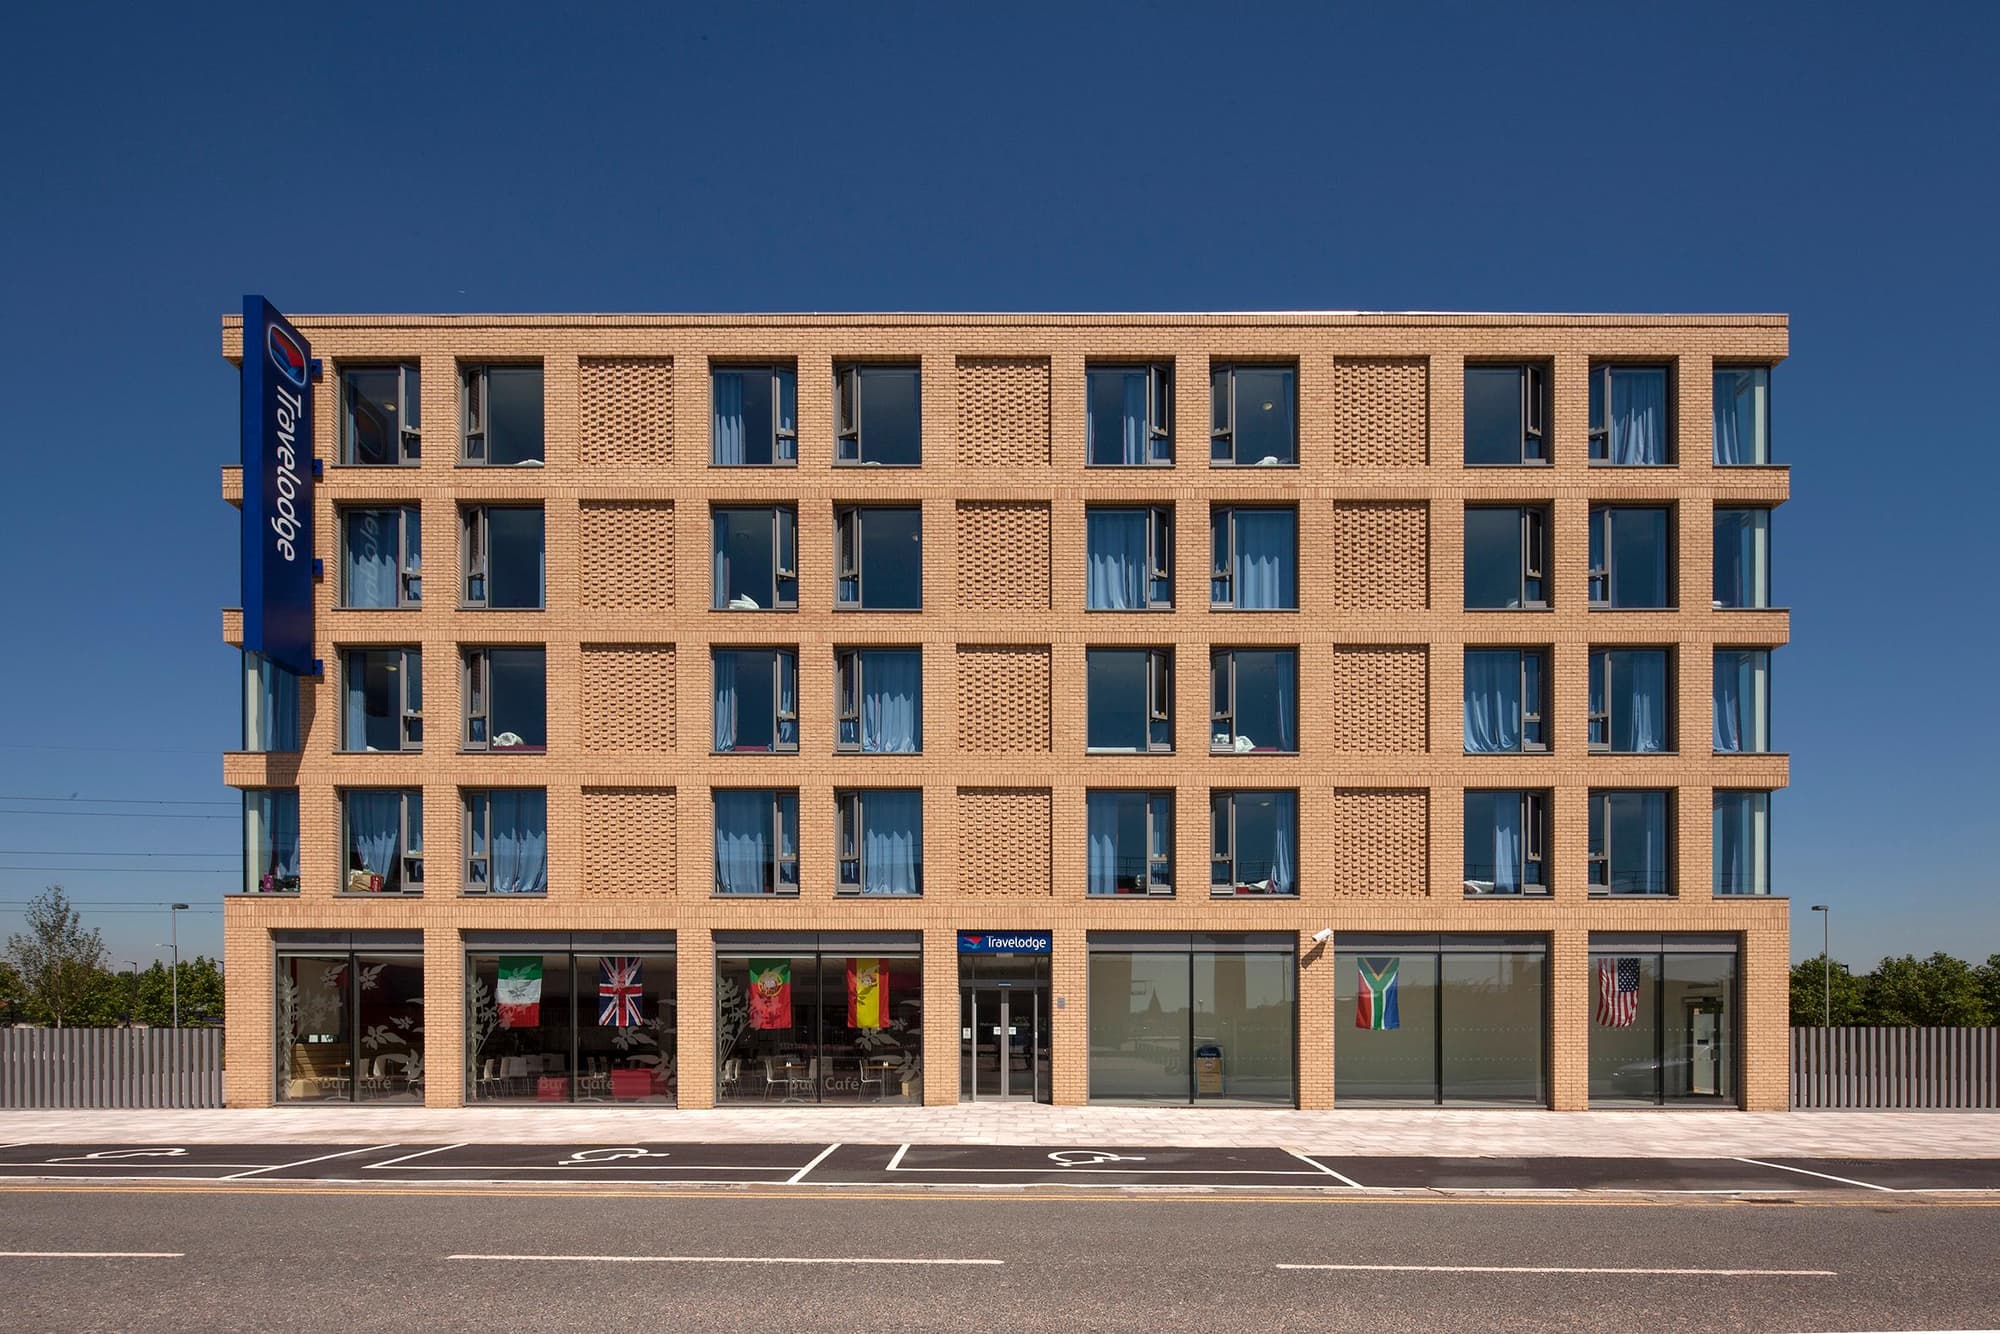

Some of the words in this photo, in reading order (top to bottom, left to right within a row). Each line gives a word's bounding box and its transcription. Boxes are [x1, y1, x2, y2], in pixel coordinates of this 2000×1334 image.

[271, 385, 302, 562] Travelodge
[986, 935, 1047, 950] Travelodge
[826, 1076, 859, 1090] Café
